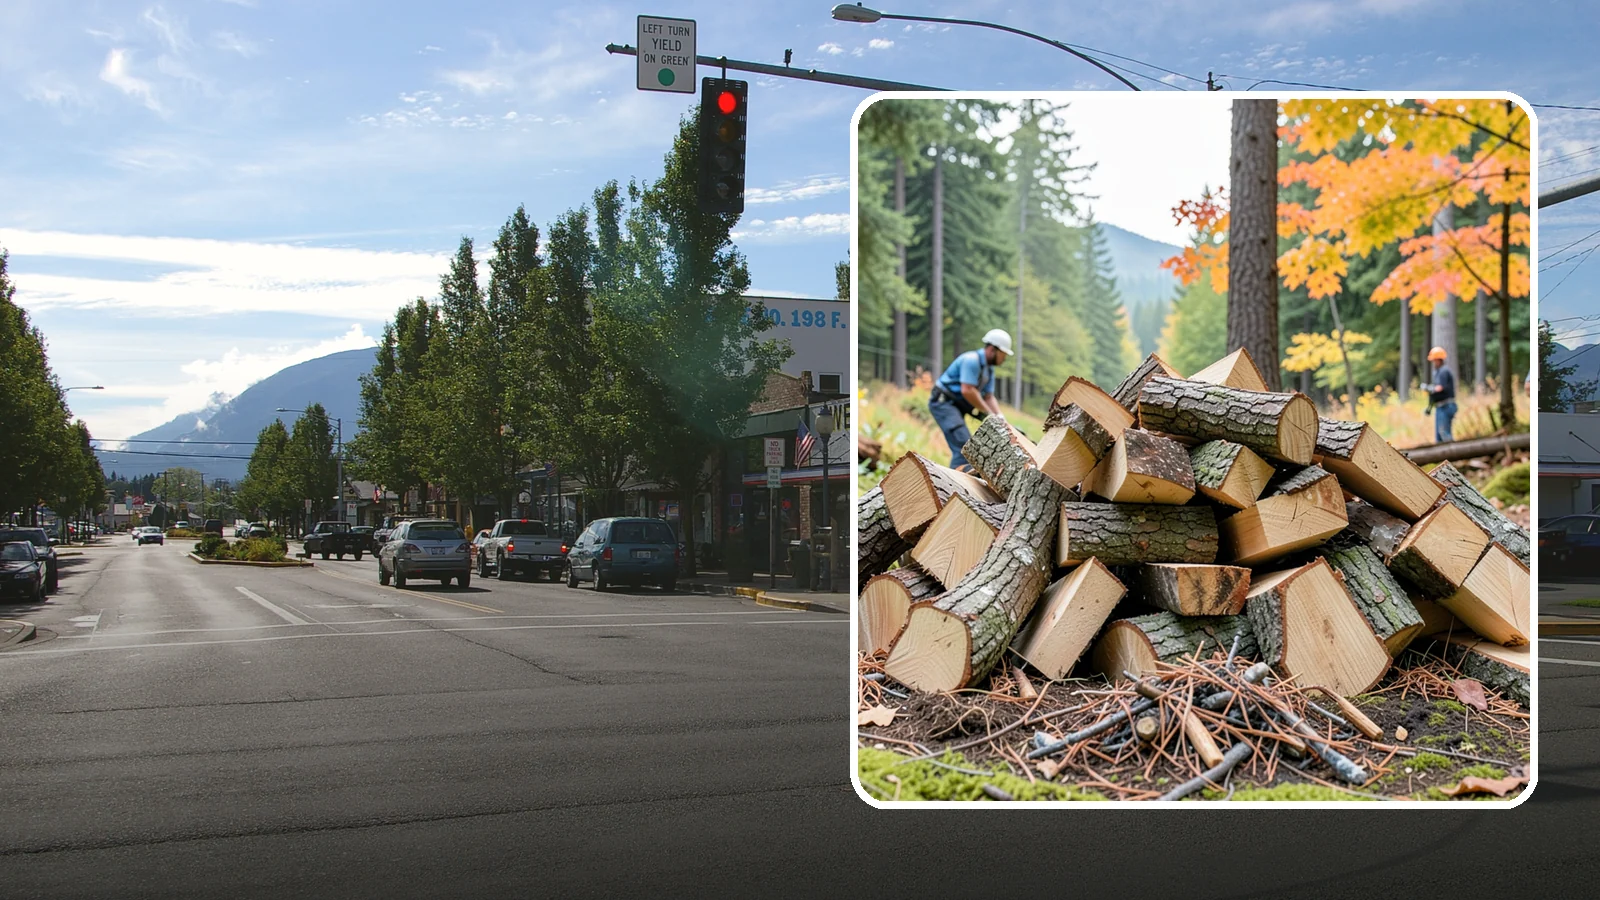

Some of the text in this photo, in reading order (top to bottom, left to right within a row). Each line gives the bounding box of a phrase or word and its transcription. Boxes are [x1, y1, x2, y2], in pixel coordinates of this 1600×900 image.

[643, 24, 690, 36] LEFT TURN
[652, 38, 681, 52] YIELD
[644, 54, 688, 66] ON GREEN
[791, 309, 826, 328] 198
[831, 311, 847, 329] F.
